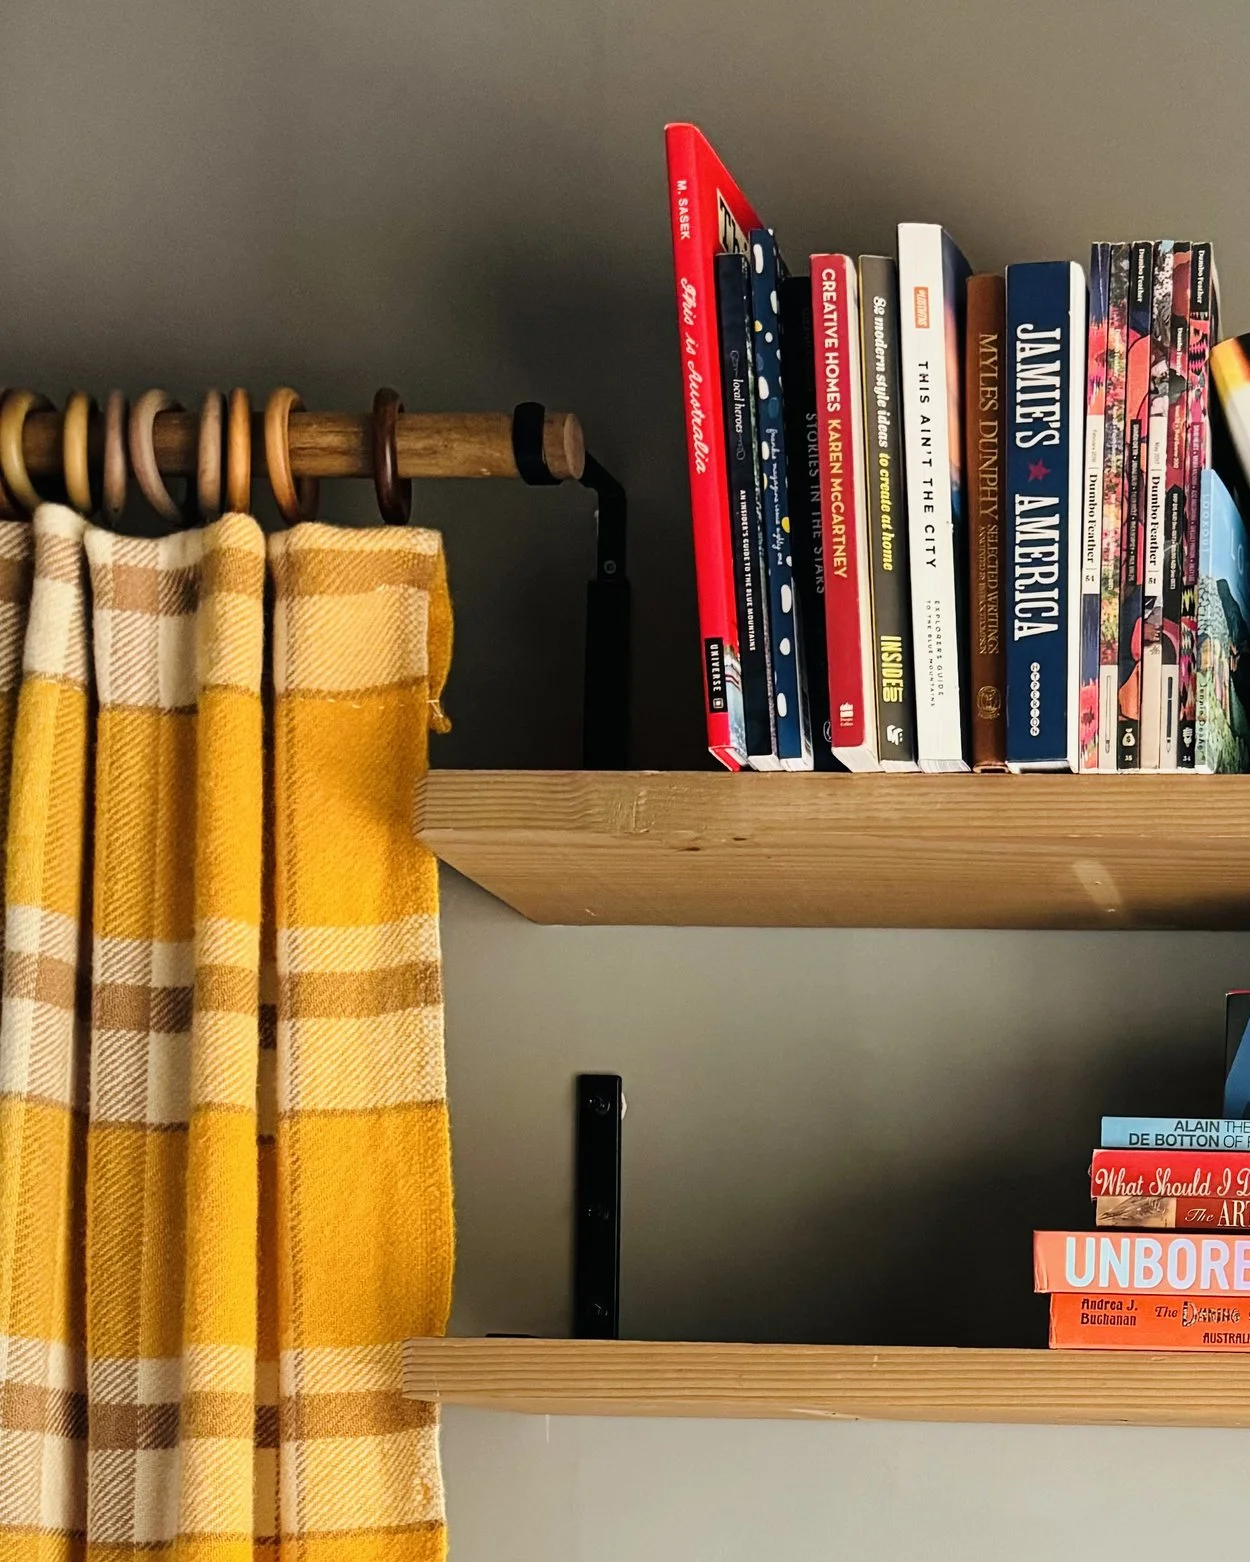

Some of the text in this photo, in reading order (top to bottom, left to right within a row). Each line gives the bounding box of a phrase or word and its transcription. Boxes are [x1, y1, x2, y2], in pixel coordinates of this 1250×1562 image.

[677, 180, 690, 240] M. SASEK
[1136, 248, 1145, 302] Dumbo Feather
[1196, 250, 1206, 304] Dumbo Feather
[680, 277, 709, 475] This is Australia
[978, 332, 998, 412] MYLES
[1175, 328, 1184, 377] Dumbo Feather
[733, 378, 746, 433] local heroes
[821, 268, 847, 579] CREATIVE HOMES KAREN McCARTNEY
[873, 296, 895, 571] 82 modern style ideas to create at home
[918, 361, 937, 569] THIS AIN'T THE CITY
[978, 419, 998, 520] DUNPHY
[1014, 323, 1061, 641] JAMIE'S AMERICA
[1087, 474, 1099, 563] Dumbo Feather
[1149, 476, 1161, 566] Dumbo Feather
[1202, 493, 1210, 553] LOOKOUT
[742, 538, 750, 561] GUIDE
[743, 561, 751, 572] TO
[744, 573, 752, 587] THE
[745, 588, 753, 607] BLUE
[746, 608, 756, 651] MOUNTAINS
[934, 600, 944, 697] EXPLORERS GUIDE
[710, 643, 722, 692] UNIVERSE
[880, 635, 904, 687] INSIDE
[1030, 662, 1040, 737] HYPERION
[1129, 1133, 1150, 1146] DE
[1155, 1133, 1220, 1148] BOTTON
[1223, 1135, 1244, 1148] OF
[1174, 1120, 1220, 1133] ALAIN
[1095, 1168, 1144, 1197] What
[1148, 1167, 1212, 1197] Should
[1216, 1168, 1232, 1197] I
[1184, 1208, 1215, 1222] The
[1080, 1298, 1138, 1311] Andrea J.
[1080, 1312, 1137, 1326] Buchanan
[1155, 1306, 1178, 1318] The
